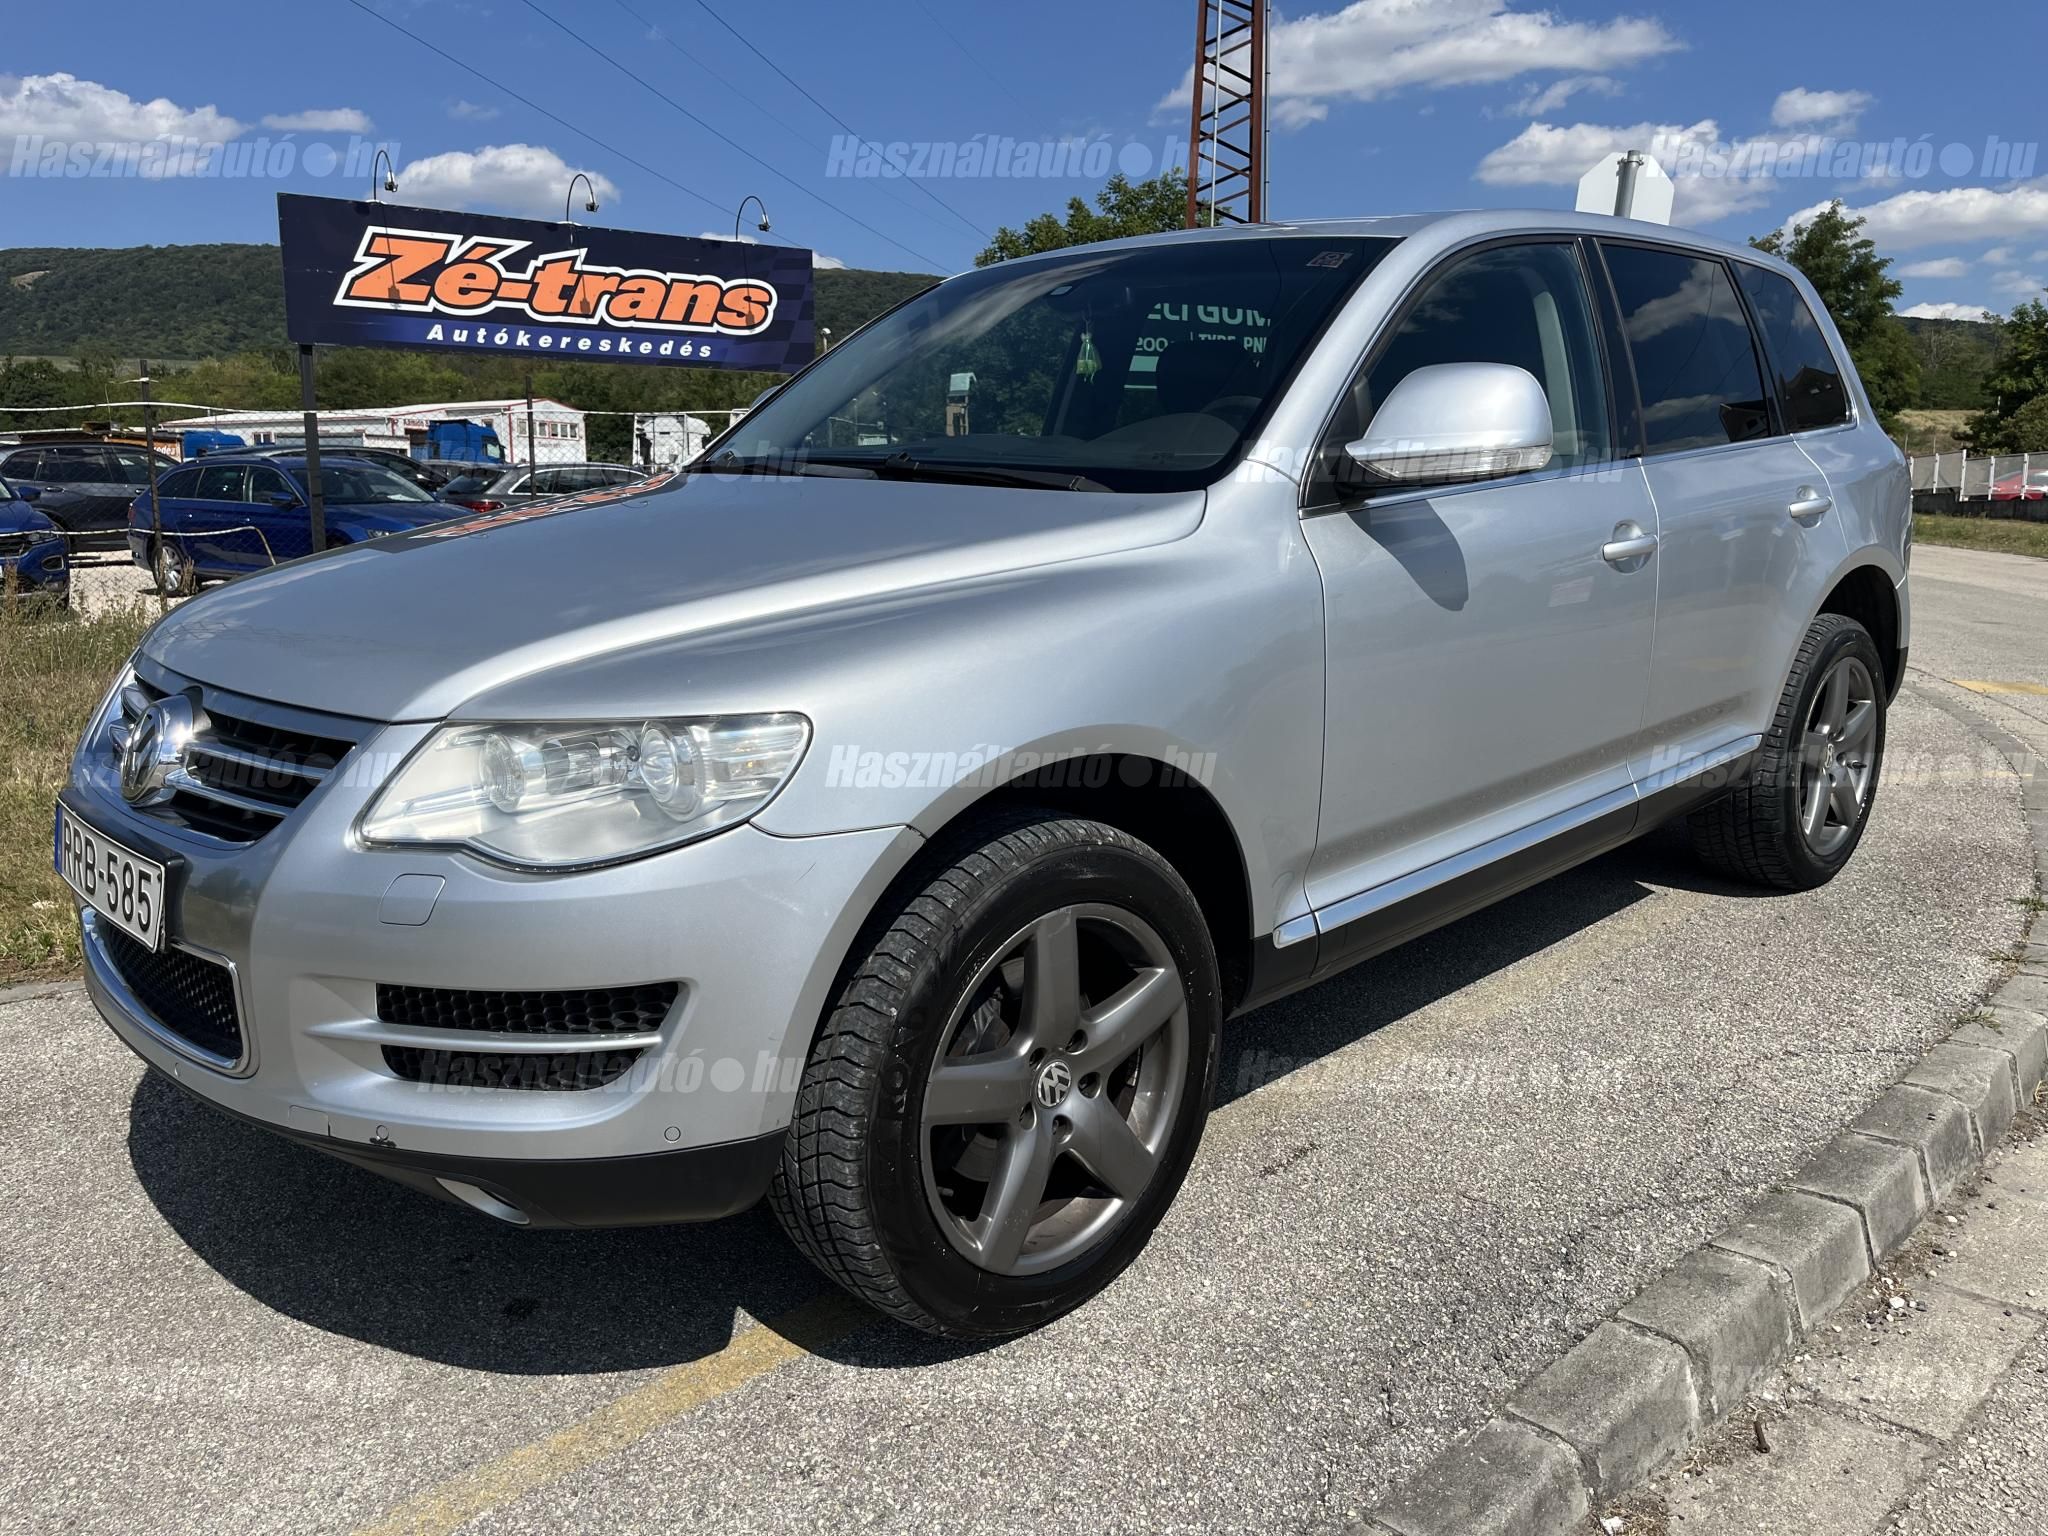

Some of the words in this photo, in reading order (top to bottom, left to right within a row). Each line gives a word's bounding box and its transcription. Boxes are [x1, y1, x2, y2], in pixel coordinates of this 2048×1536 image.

[334, 226, 777, 335] Zé-trans
[426, 323, 712, 357] Autókereskedés
[63, 815, 153, 933] RRB-585
